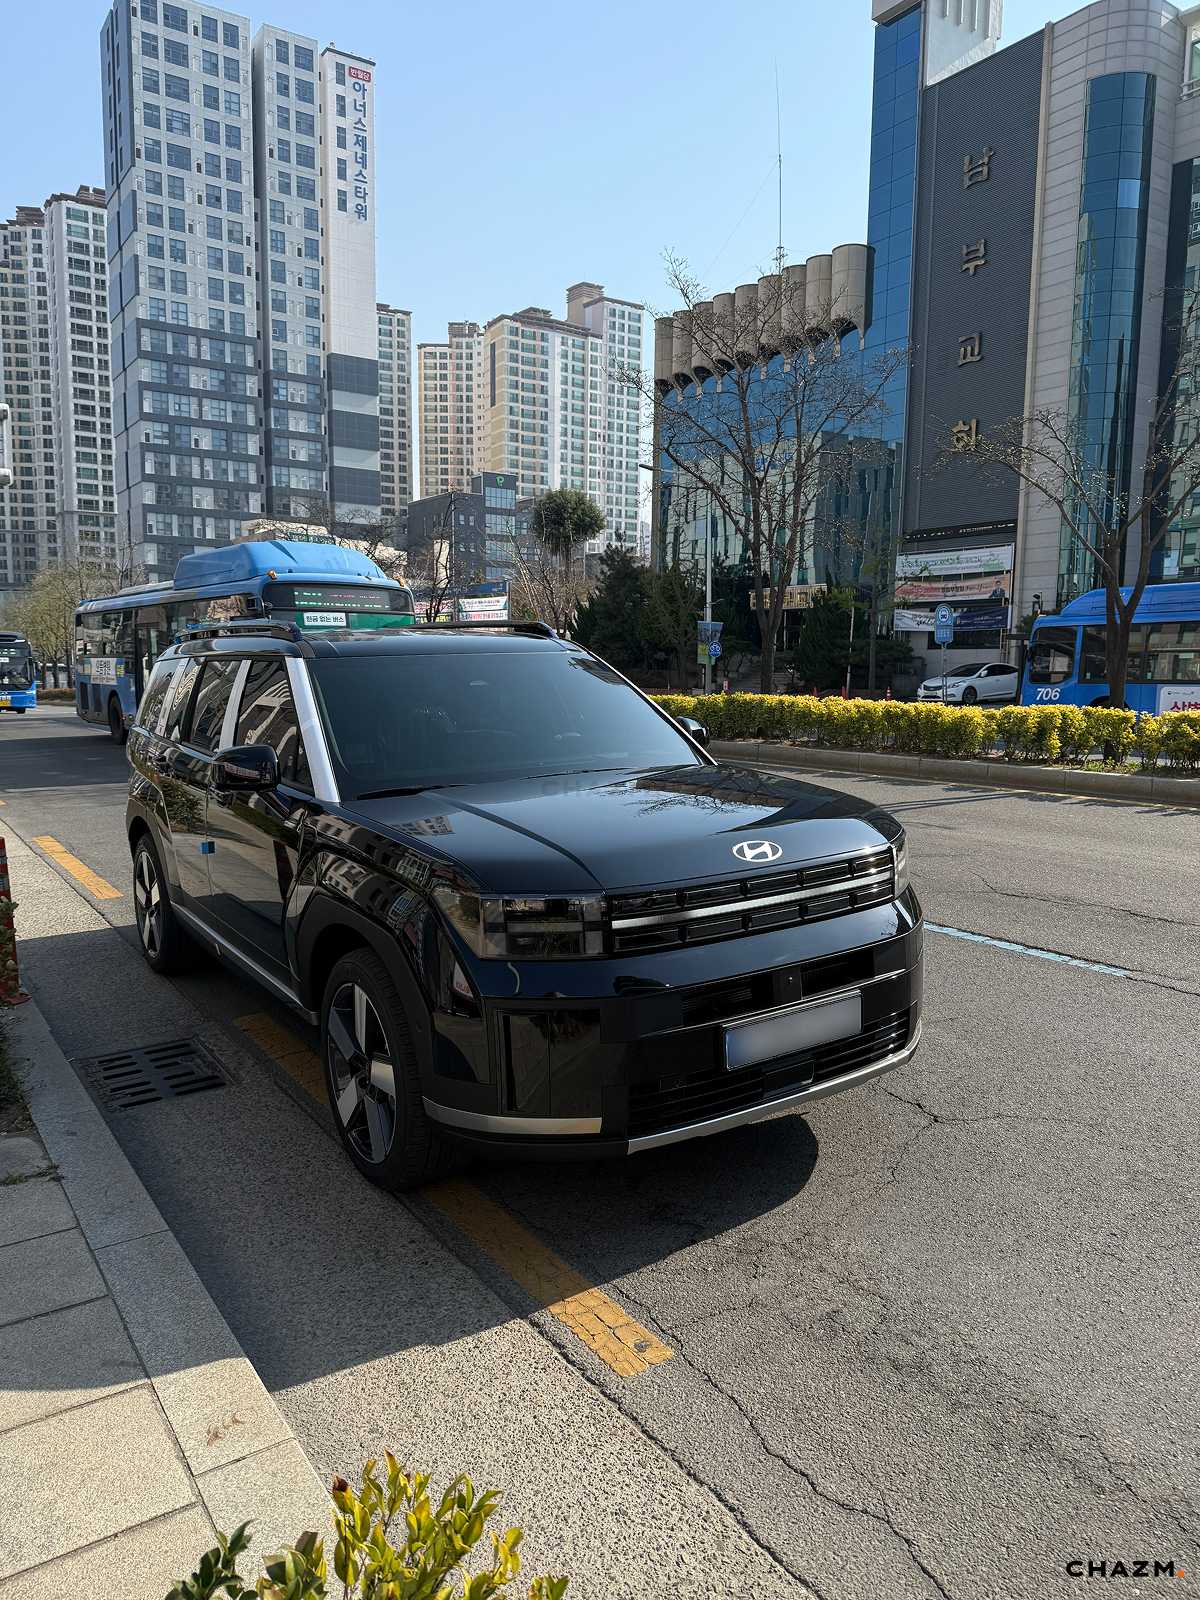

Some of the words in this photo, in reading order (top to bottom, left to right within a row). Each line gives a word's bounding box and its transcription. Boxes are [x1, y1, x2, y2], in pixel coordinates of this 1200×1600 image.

[350, 68, 370, 81] 반월당
[353, 81, 368, 221] 아너스제네스타워
[950, 146, 994, 452] 남부교회
[319, 615, 332, 623] 없는
[1036, 688, 1061, 701] 706
